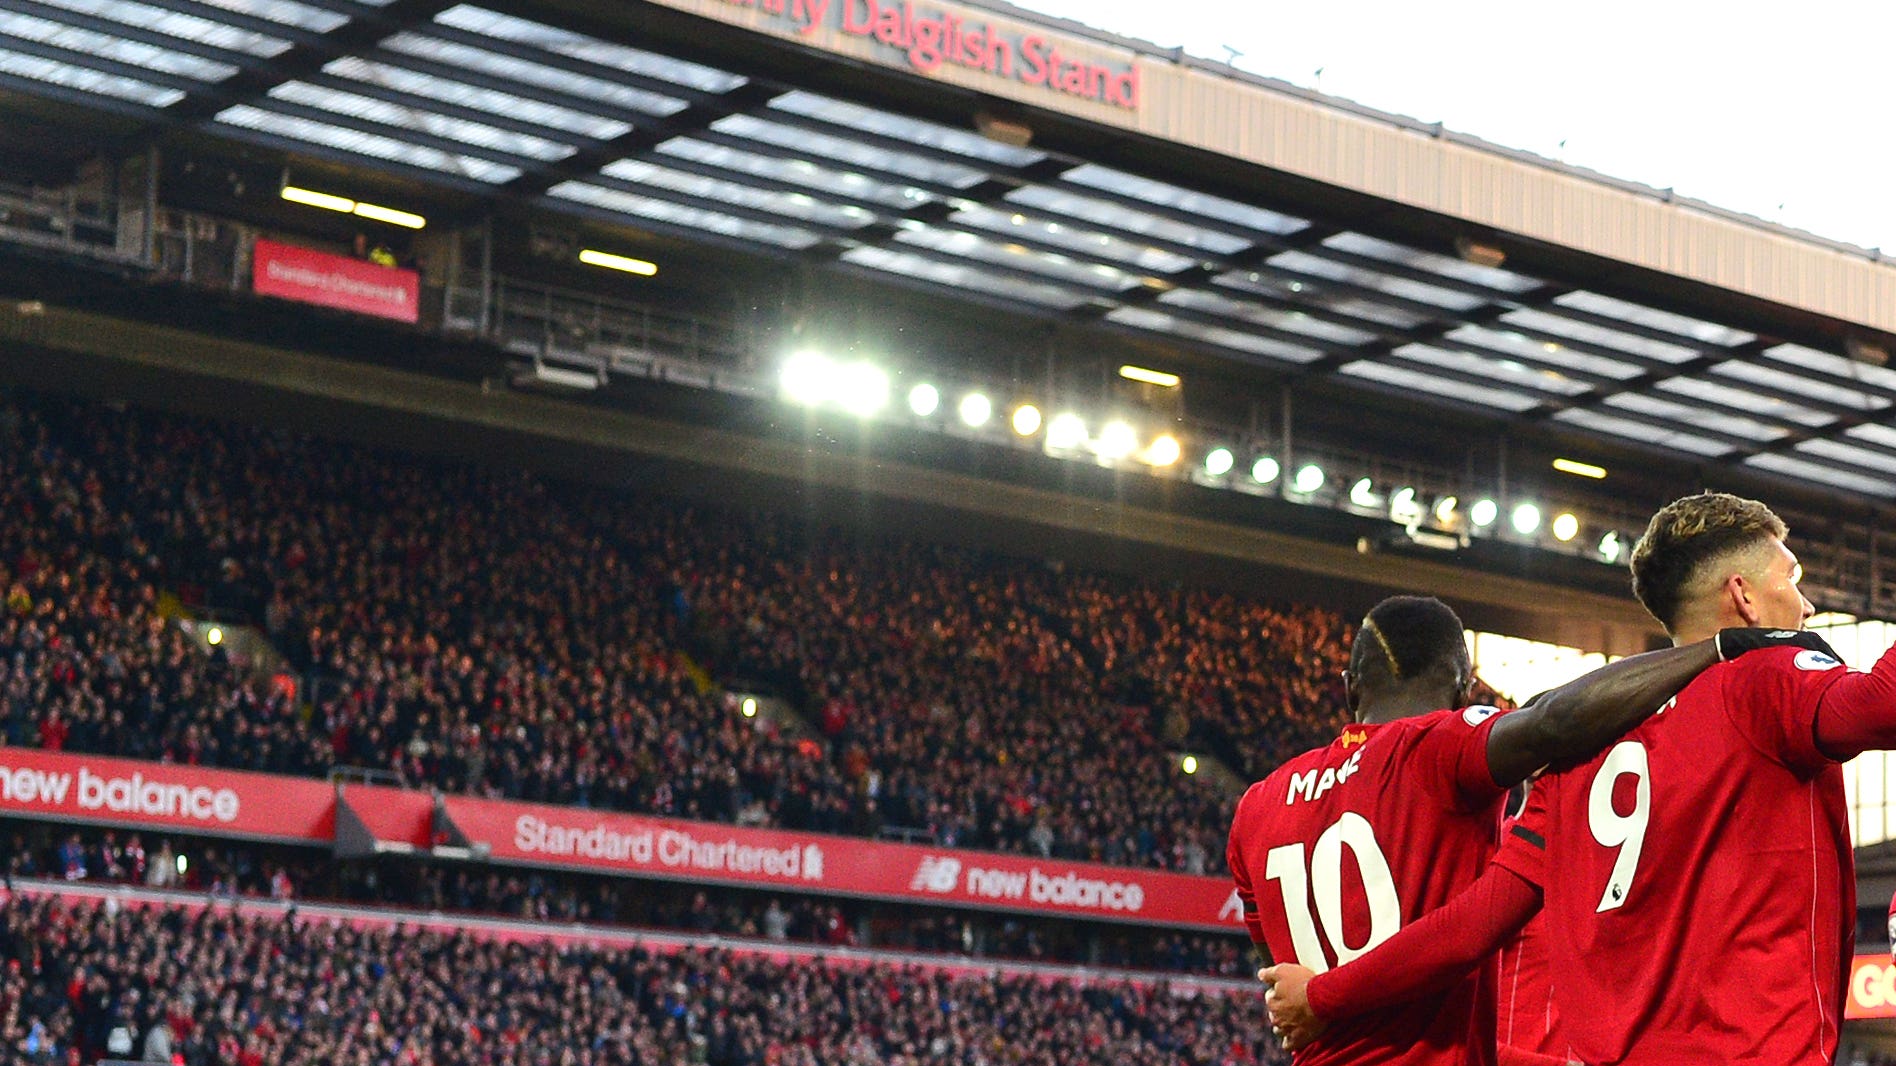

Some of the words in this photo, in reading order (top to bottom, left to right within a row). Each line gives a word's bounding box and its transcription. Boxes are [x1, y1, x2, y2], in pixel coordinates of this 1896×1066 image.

[842, 0, 1014, 72] Dalglish
[1021, 35, 1143, 109] Stand
[0, 765, 73, 804] new
[77, 765, 241, 823] balance
[1588, 740, 1651, 913] 9
[514, 814, 652, 864] Standard
[657, 829, 802, 878] Chartered
[966, 866, 1030, 899] new
[1029, 867, 1146, 912] balance
[1264, 810, 1402, 976] 10
